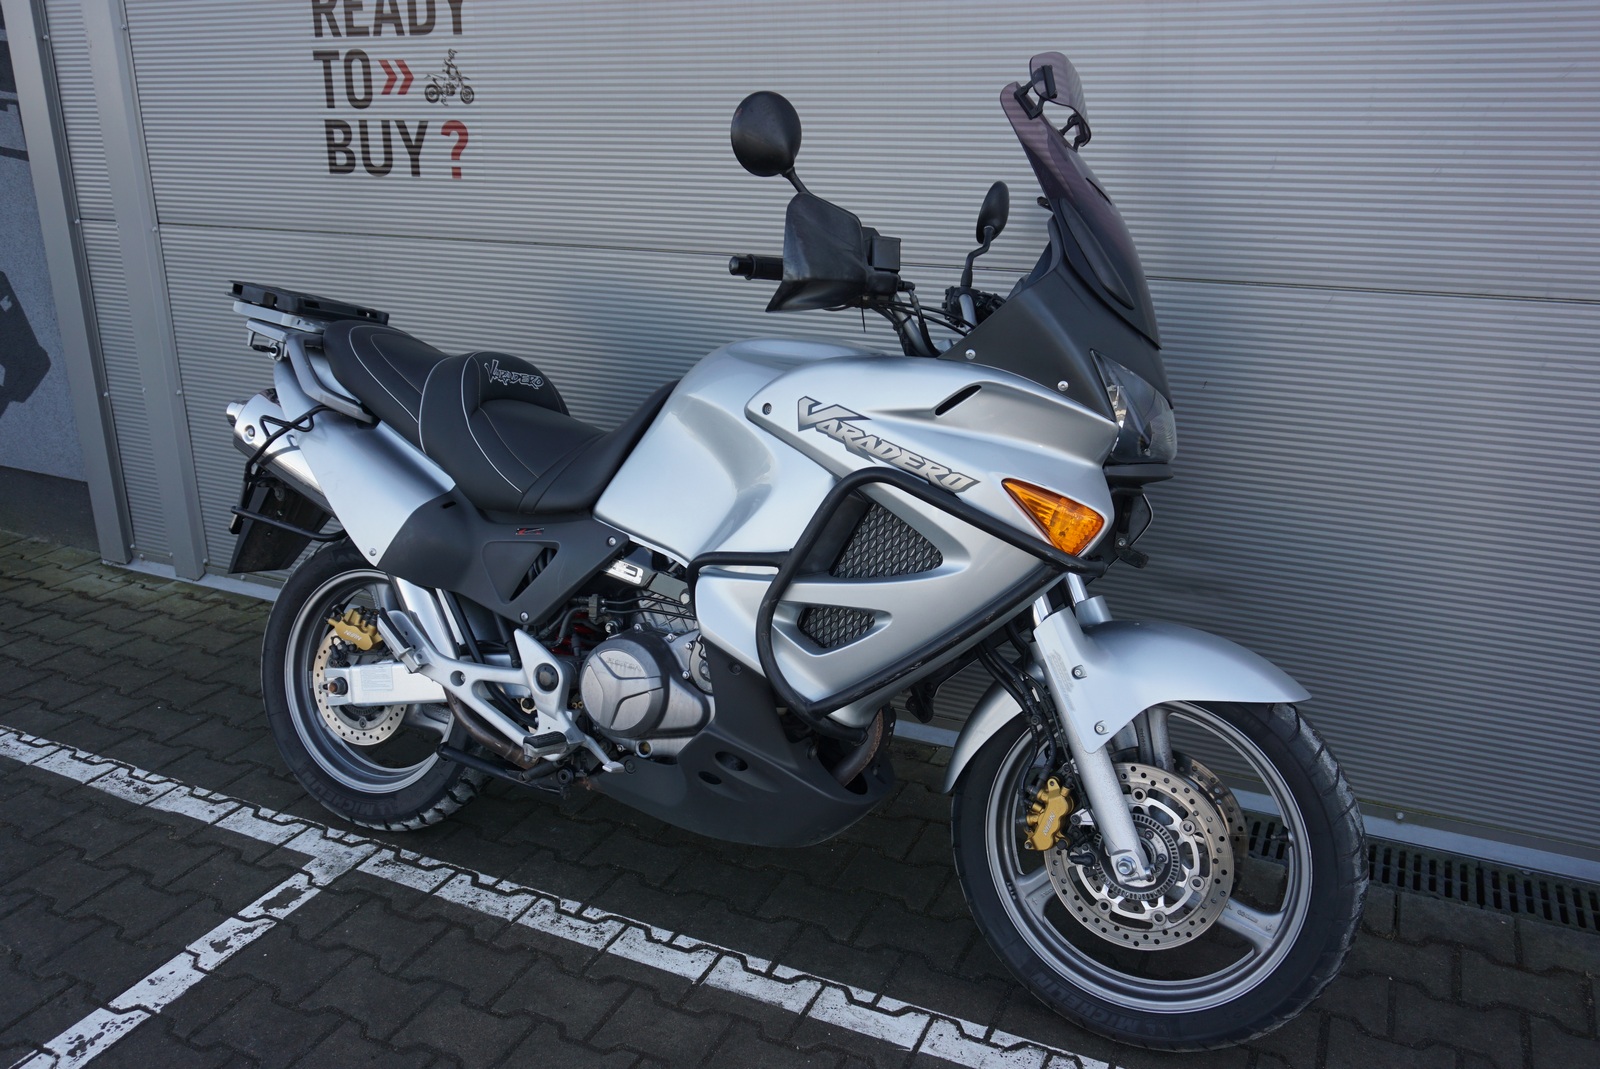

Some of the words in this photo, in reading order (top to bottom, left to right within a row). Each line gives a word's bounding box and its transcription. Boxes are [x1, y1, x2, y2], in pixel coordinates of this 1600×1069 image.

[312, 0, 463, 37] READY
[313, 49, 373, 109] TO
[798, 396, 981, 492] VARADERO
[301, 771, 375, 815] MICHELIN
[1031, 971, 1141, 1033] MICHELIN
